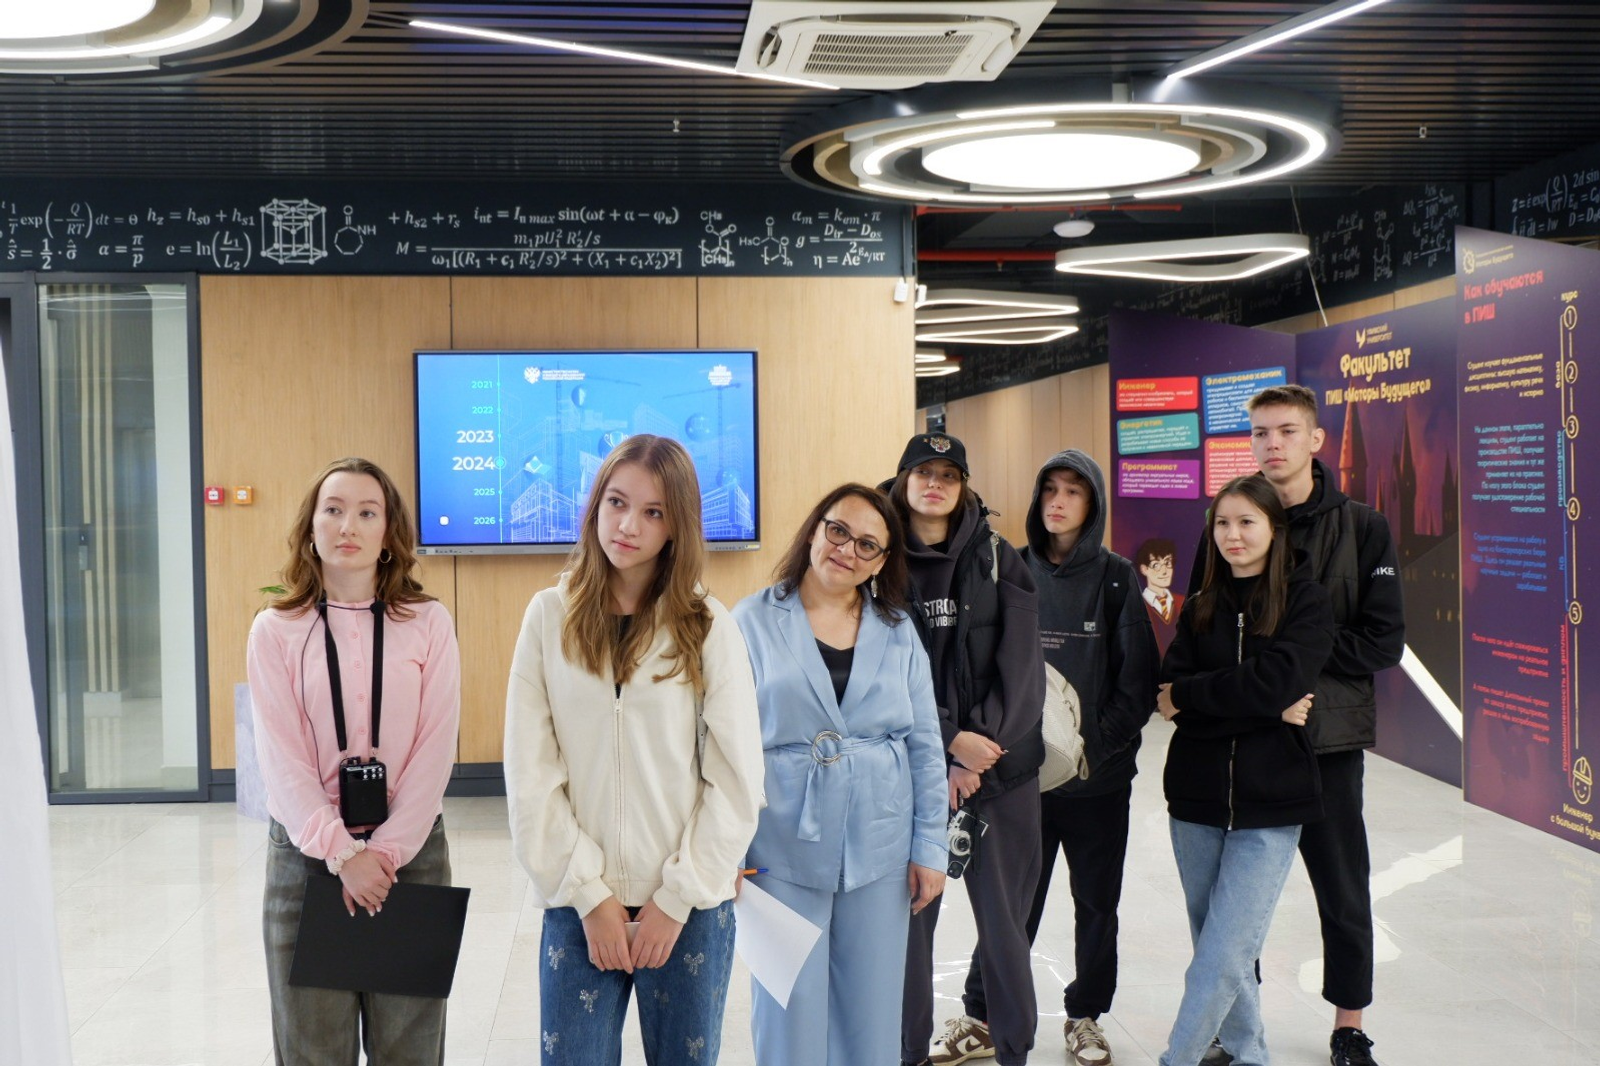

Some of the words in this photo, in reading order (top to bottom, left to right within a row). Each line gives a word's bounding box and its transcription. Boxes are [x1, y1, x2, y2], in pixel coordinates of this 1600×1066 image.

[357, 225, 376, 236] NH
[1464, 283, 1482, 301] Как
[1485, 270, 1544, 298] обучаются
[1464, 310, 1471, 324] в
[1472, 302, 1496, 323] ПИШ
[1340, 347, 1412, 382] Факультет
[471, 380, 493, 389] 2021
[472, 406, 494, 414] 2022
[456, 430, 494, 444] 2023
[452, 456, 496, 470] 2024
[1122, 462, 1178, 472] Программист
[473, 488, 496, 496] 2025
[473, 516, 496, 525] 2026
[1562, 802, 1594, 824] Инженер
[1556, 814, 1584, 834] большой
